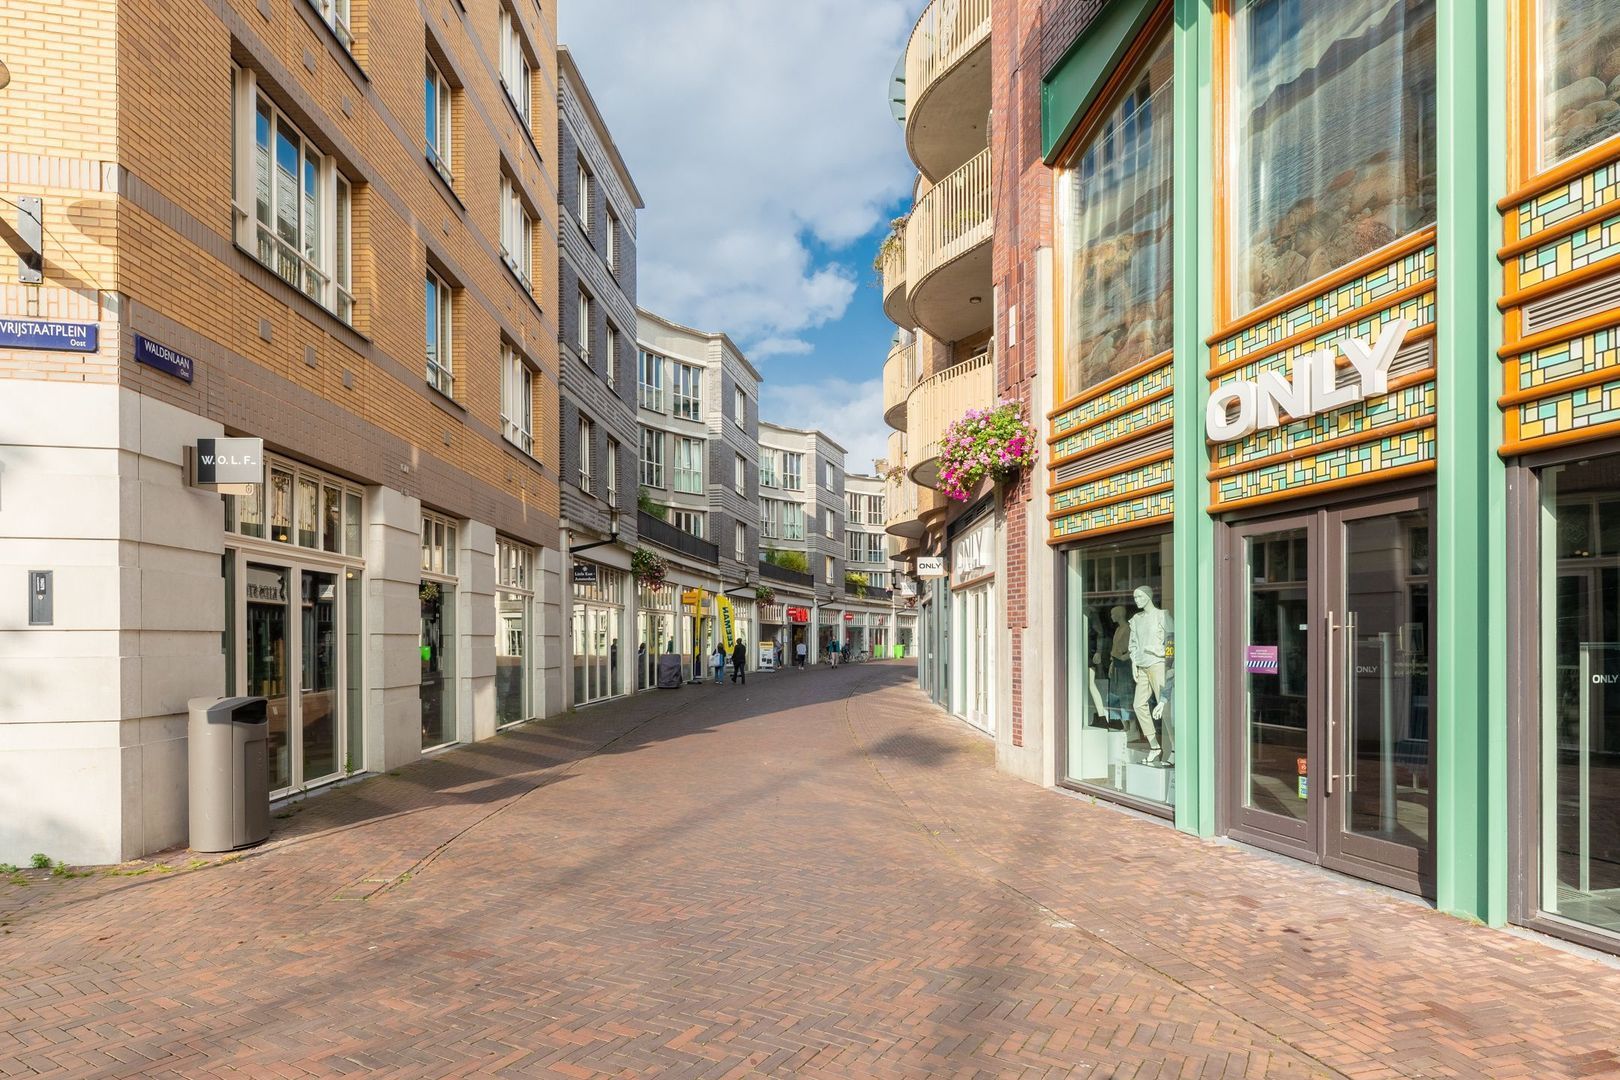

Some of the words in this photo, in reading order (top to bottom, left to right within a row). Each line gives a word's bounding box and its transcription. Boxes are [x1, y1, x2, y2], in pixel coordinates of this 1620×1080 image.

[0, 322, 87, 337] VRIJSTAATPLEIN
[70, 339, 86, 347] Oost
[144, 340, 190, 369] WALDENLAAN
[180, 368, 190, 378] Oost
[1206, 319, 1410, 441] ONLY
[1356, 665, 1378, 673] ONLY
[1592, 674, 1619, 684] ONLY
